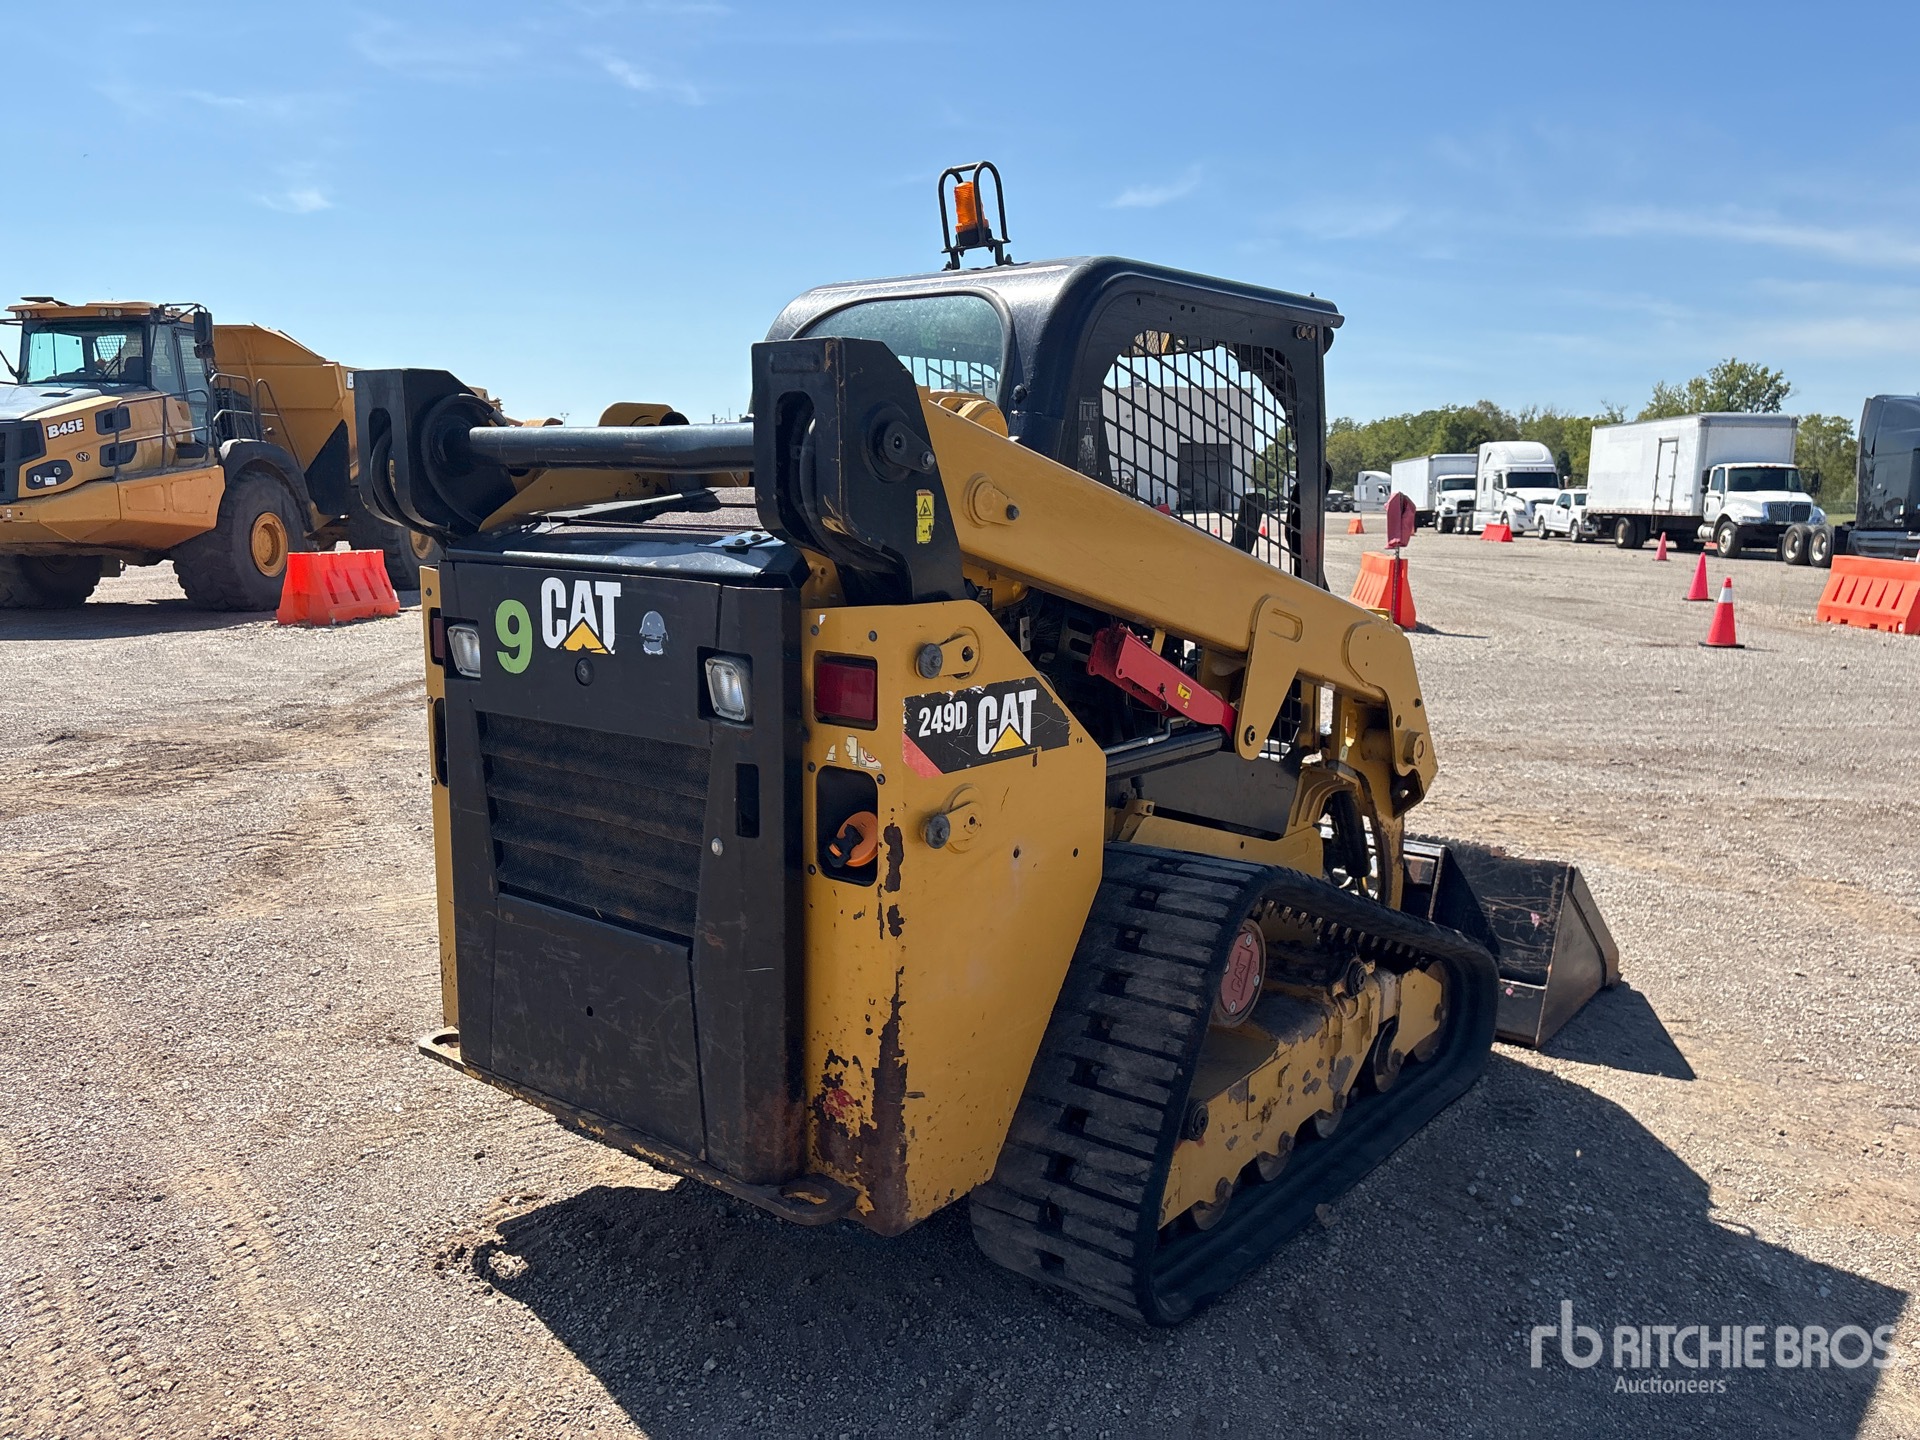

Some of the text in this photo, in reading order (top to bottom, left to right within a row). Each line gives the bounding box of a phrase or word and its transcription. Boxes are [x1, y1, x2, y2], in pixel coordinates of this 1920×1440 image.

[47, 419, 84, 439] B45E
[495, 600, 533, 674] 9
[541, 577, 622, 655] CAT
[918, 688, 1037, 755] 249D CAT
